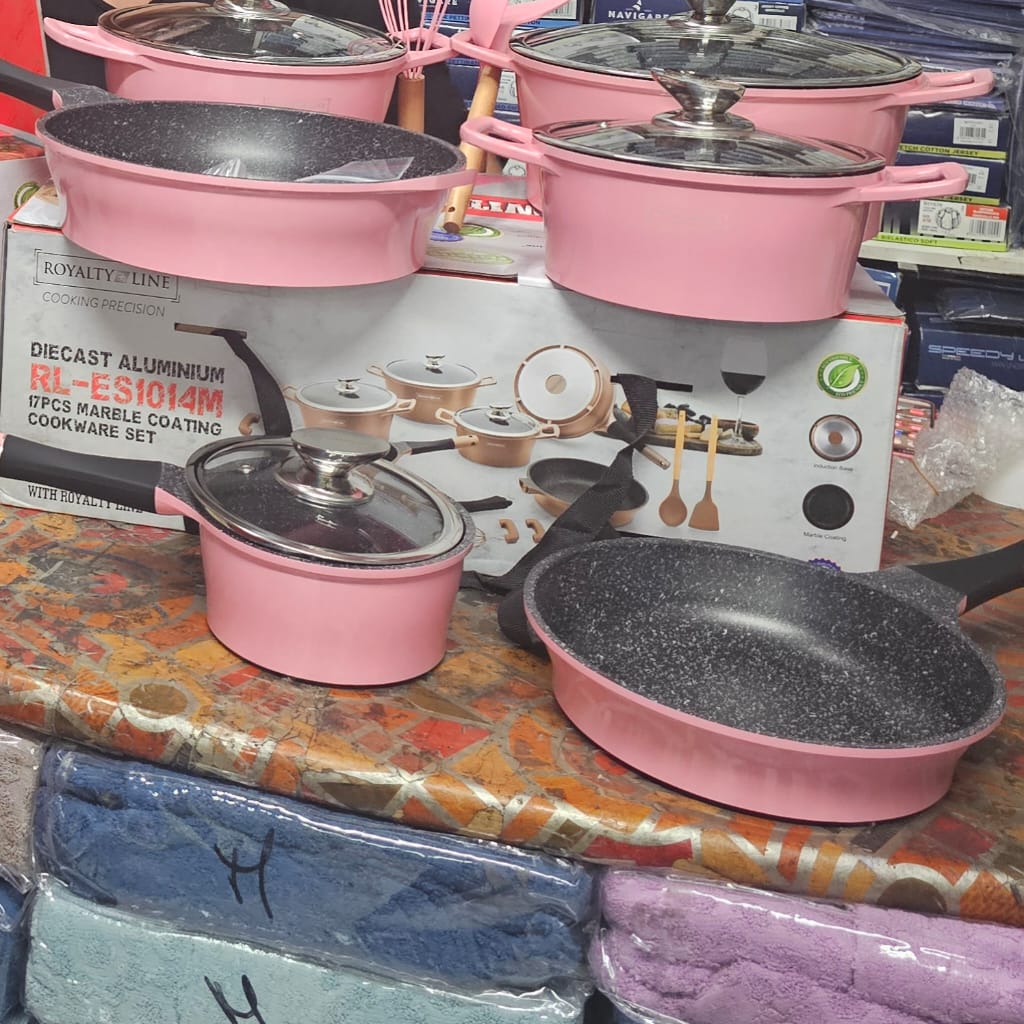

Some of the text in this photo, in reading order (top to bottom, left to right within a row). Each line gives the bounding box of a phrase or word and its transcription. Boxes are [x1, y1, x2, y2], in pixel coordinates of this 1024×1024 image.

[44, 261, 170, 289] ROYALTY LINE
[42, 291, 165, 318] COOKING PRECISION
[31, 341, 225, 384] DIECAST ALUMINIUM
[928, 344, 1014, 360] SPEEDY
[30, 363, 224, 419] RL-ES1014M
[28, 395, 222, 437] 17PCS MARBLE COATING
[28, 412, 157, 444] COOKWARE SET
